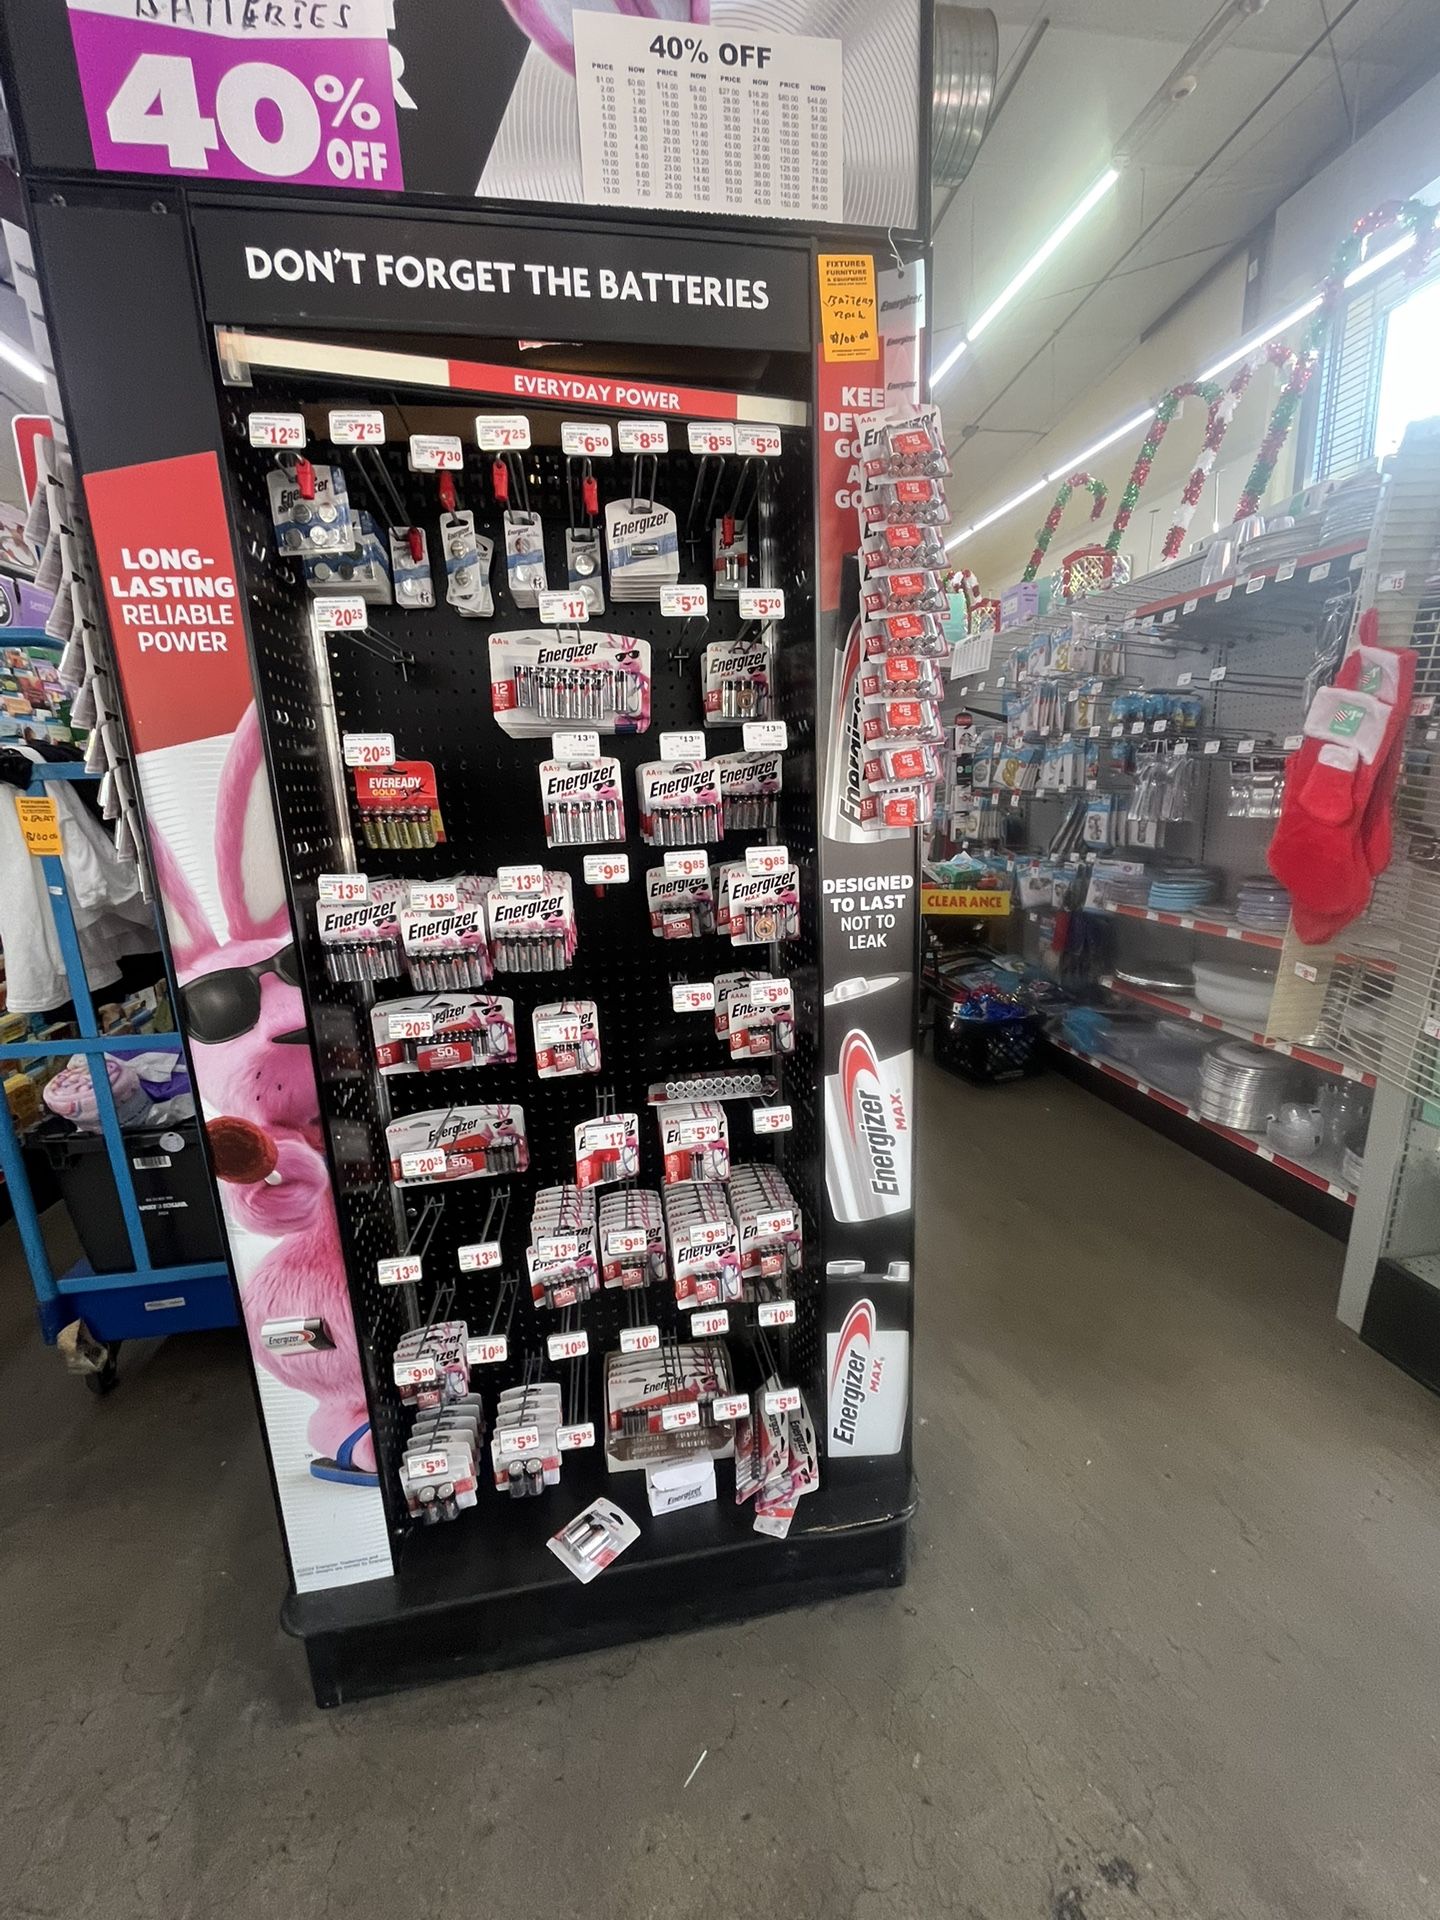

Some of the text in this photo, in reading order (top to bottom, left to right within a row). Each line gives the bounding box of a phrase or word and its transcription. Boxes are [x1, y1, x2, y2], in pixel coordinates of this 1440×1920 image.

[650, 34, 772, 70] 40% OFF
[592, 62, 614, 71] PRICE
[628, 66, 646, 74] NOW
[657, 69, 678, 77] PRICE
[690, 72, 707, 80] NOW
[720, 75, 741, 84] PRICE
[753, 79, 769, 87] NOW
[779, 81, 800, 89] PRICE
[326, 138, 388, 182] OFF
[245, 247, 769, 310] DON'T FORGET THE BATTERIES
[514, 374, 681, 410] EVERYDAY POWER
[842, 386, 885, 407] KEE
[866, 461, 880, 471] 15
[867, 507, 880, 516] 15
[612, 512, 668, 538] Energizer
[121, 548, 214, 570] LONG-
[866, 552, 880, 562] 15
[110, 576, 235, 598] LASTING
[867, 597, 878, 605] 15
[122, 604, 234, 625] RELIABLE
[138, 631, 228, 652] POWER
[867, 639, 879, 648] 15
[537, 643, 598, 664] Energizer
[710, 652, 767, 674] Energizer
[493, 683, 508, 694] 12
[863, 679, 876, 688] 15
[708, 693, 718, 701] 12
[864, 722, 877, 731] 15
[720, 759, 778, 784] Energizer
[866, 764, 878, 773] 15
[369, 777, 421, 788] EVEREADY
[548, 765, 615, 795] Energizer
[650, 769, 715, 798] Energizer
[861, 801, 873, 810] 15
[732, 872, 795, 900] Energizer
[822, 875, 913, 894] DESIGNED
[495, 895, 564, 923] Energizer
[831, 895, 906, 912] TO LAST
[928, 896, 1002, 908] CLEARANCE
[324, 900, 396, 932] Energizer
[408, 910, 477, 940] Energizer
[732, 918, 742, 927] 12
[841, 914, 895, 931] NOT TO
[849, 934, 887, 949] LEAK
[378, 1048, 390, 1057] 12
[858, 1089, 899, 1196] Energizer
[677, 1281, 687, 1289] 12
[269, 1334, 300, 1346] Energizer
[833, 1350, 867, 1446] Energizer
